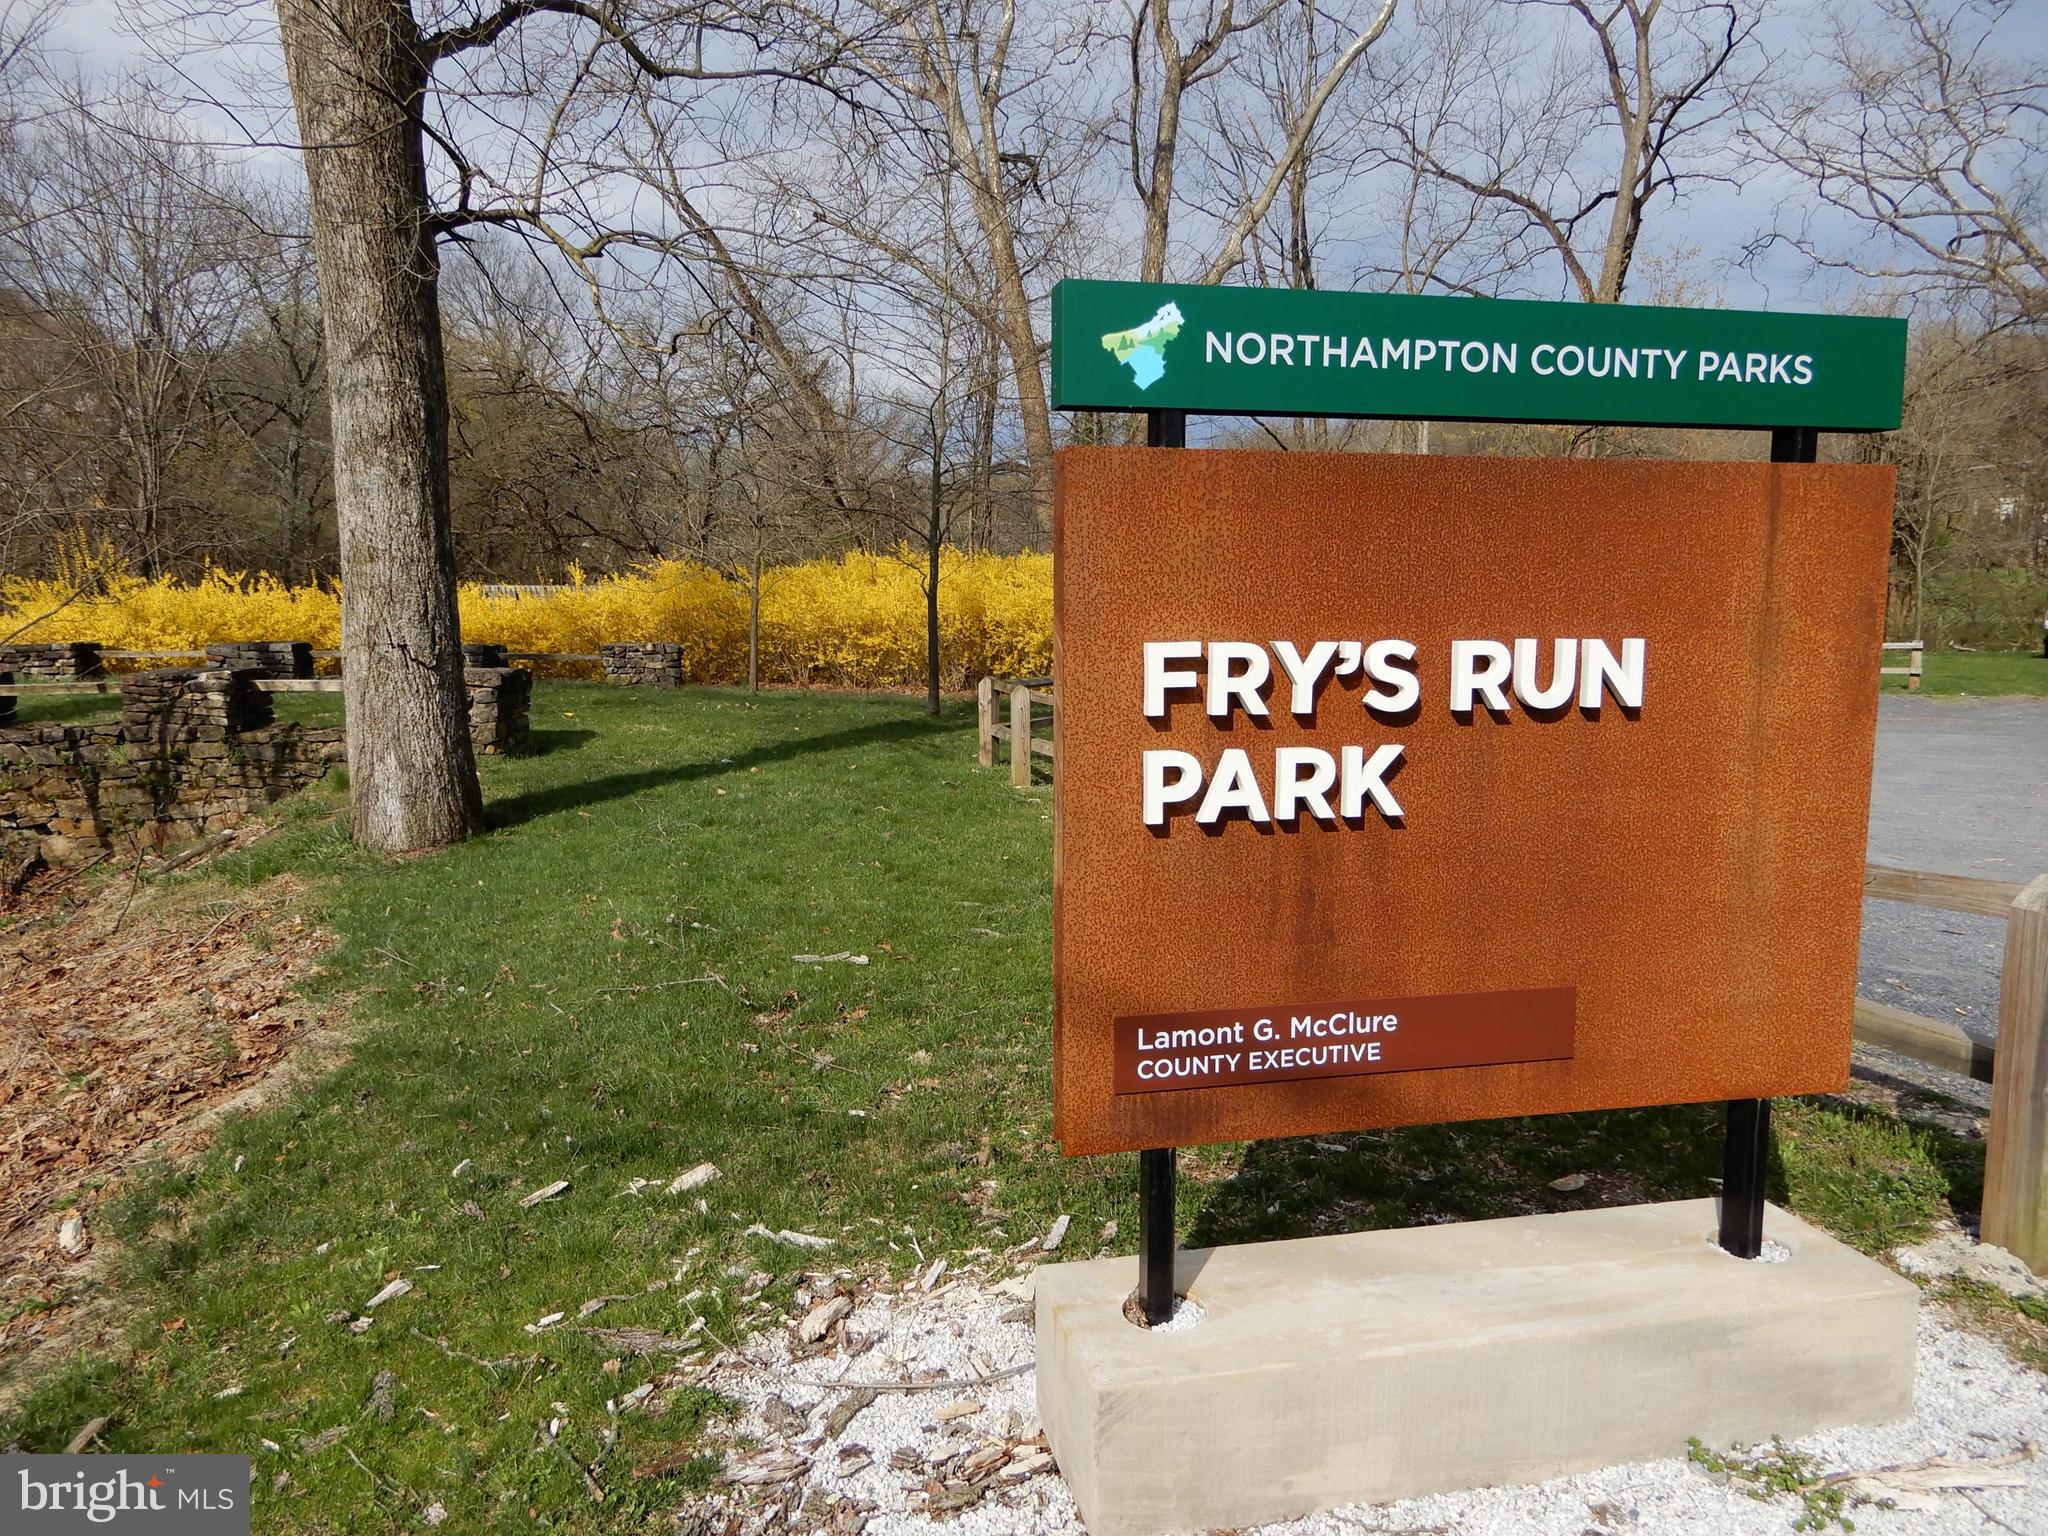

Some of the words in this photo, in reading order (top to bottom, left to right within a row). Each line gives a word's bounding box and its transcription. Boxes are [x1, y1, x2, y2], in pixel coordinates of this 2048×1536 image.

[1205, 331, 1517, 374] NORTHAMPTON
[1530, 344, 1687, 380] COUNTY
[1698, 351, 1814, 386] PARKS
[1143, 639, 1420, 717] FRY'S
[1450, 638, 1646, 712] RUN
[1143, 744, 1405, 825] PARK
[1137, 1020, 1244, 1051] Lamont
[1253, 1019, 1280, 1041] G.
[1290, 1011, 1398, 1038] McClure
[1137, 1053, 1241, 1079] COUNTY
[1248, 1042, 1381, 1071] EXECUTIVE
